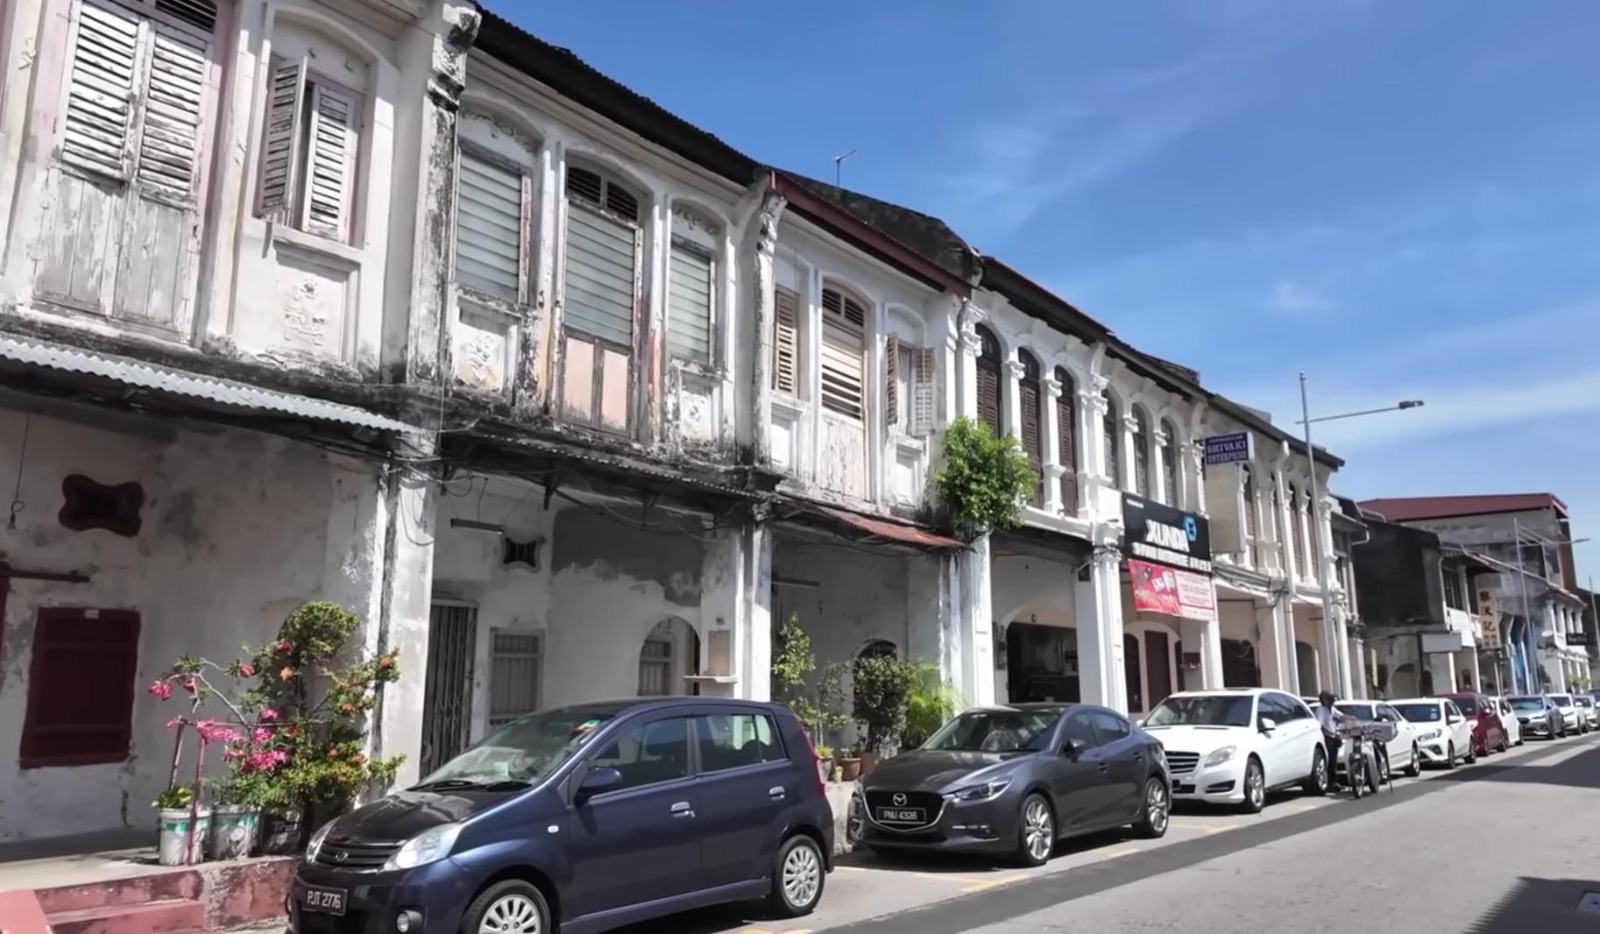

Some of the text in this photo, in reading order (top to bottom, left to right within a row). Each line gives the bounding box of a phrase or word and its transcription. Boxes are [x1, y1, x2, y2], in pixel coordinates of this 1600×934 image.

[1207, 440, 1246, 454] SHIVAKI
[1145, 519, 1190, 552] XUNDA
[884, 810, 898, 819] PNU
[306, 890, 322, 905] PJT
